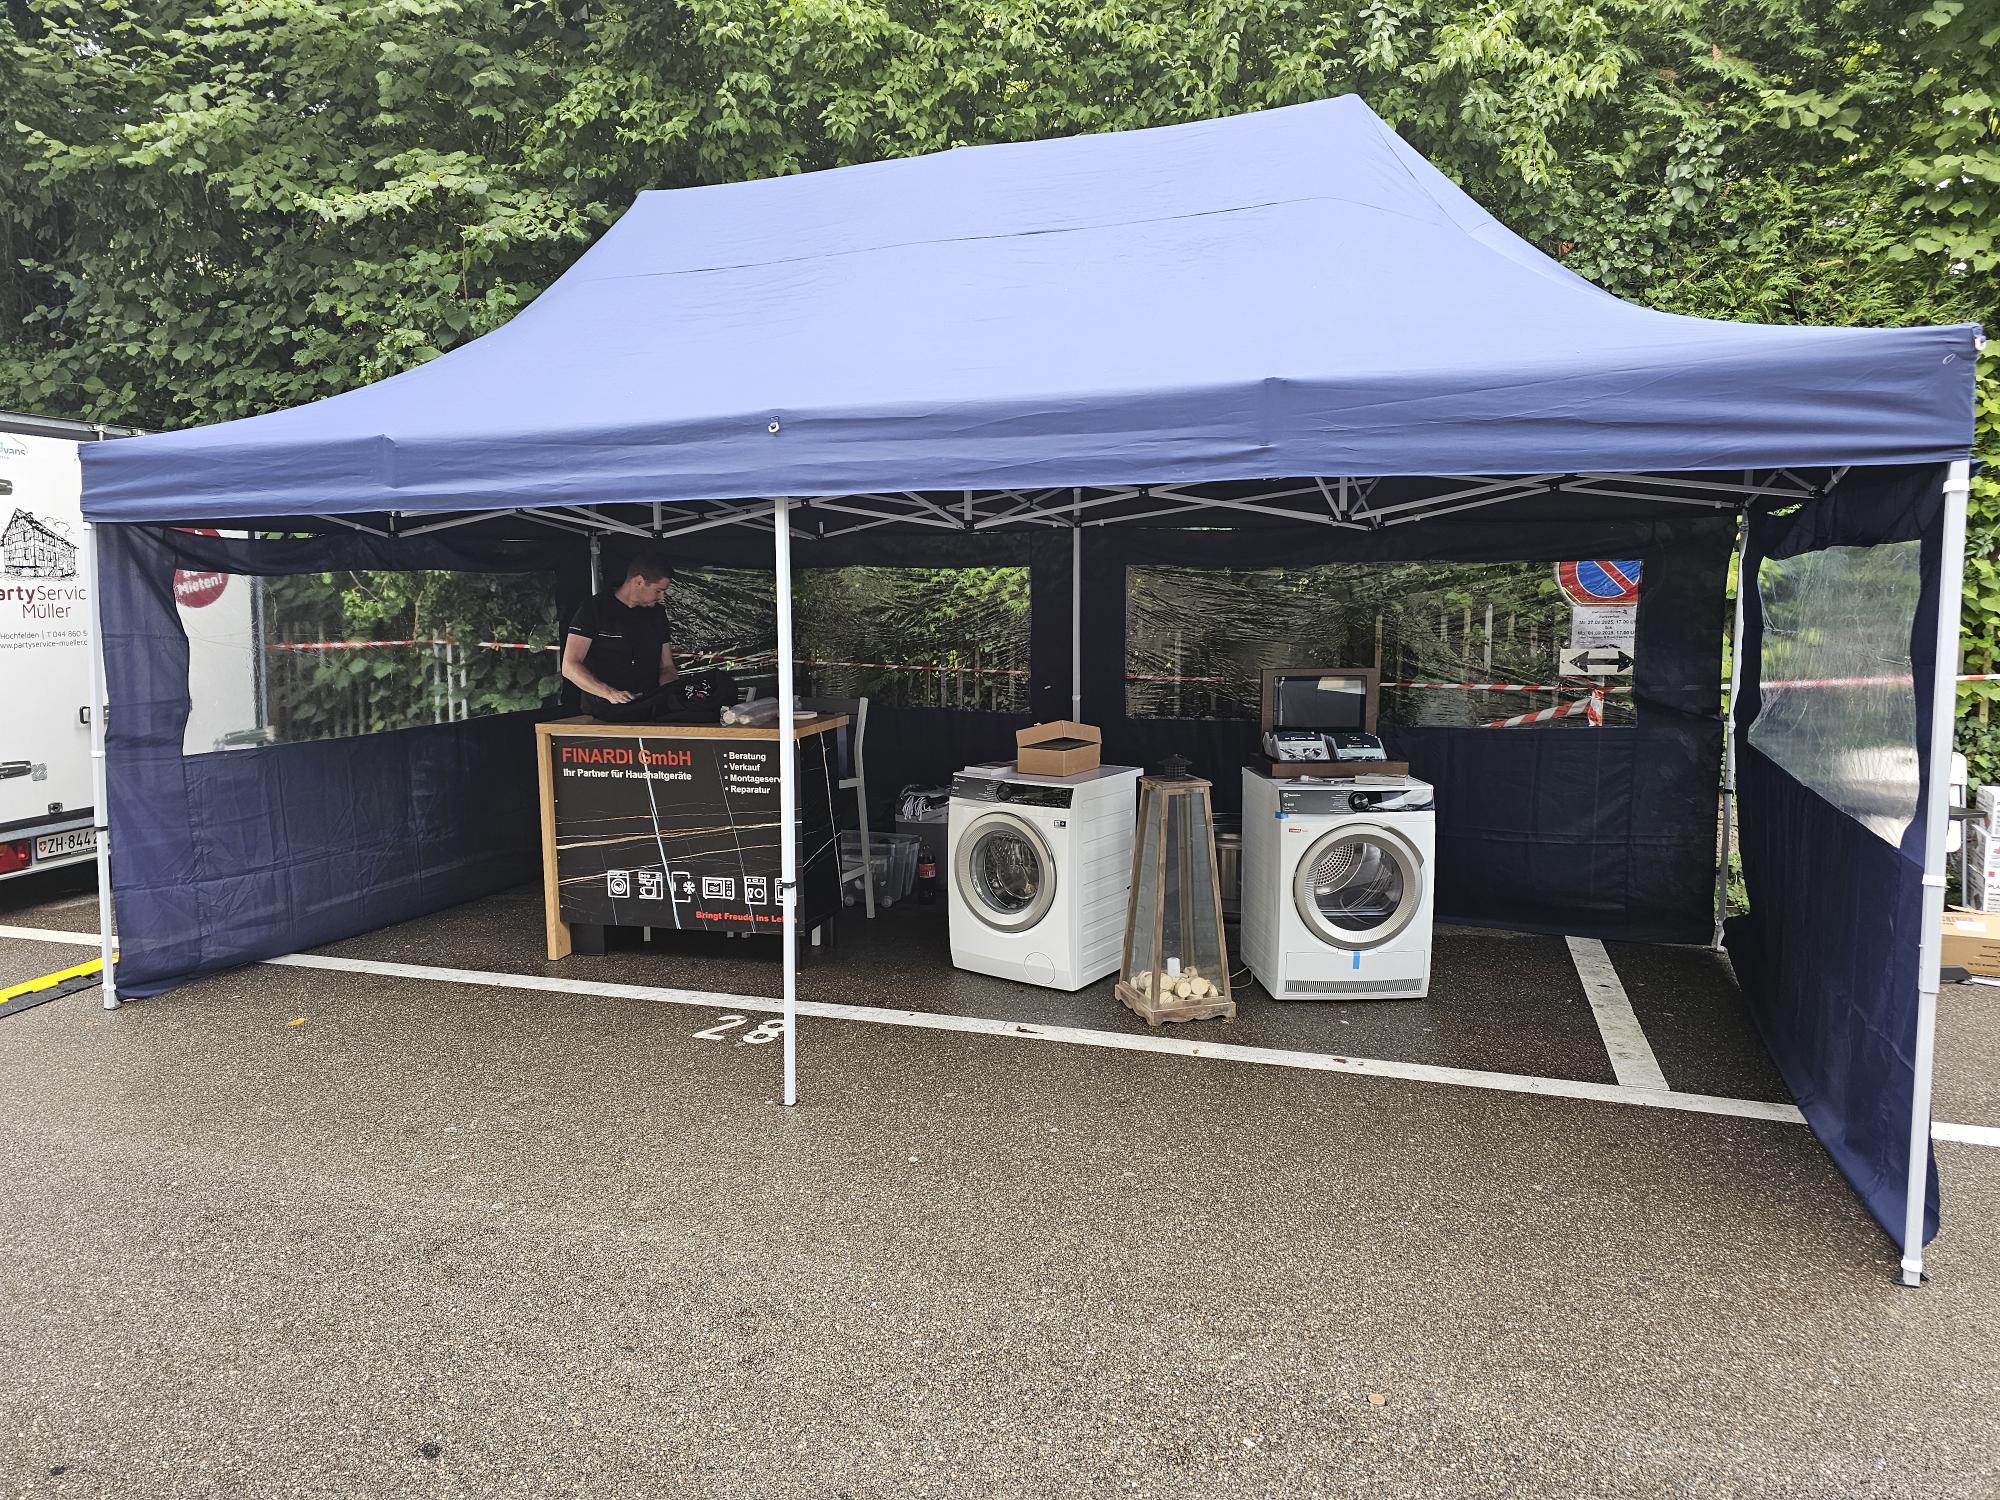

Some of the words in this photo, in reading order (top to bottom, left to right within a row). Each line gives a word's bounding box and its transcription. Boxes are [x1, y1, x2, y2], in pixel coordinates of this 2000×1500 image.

[22, 603, 72, 619] Müller
[562, 747, 633, 765] FINARDI
[638, 749, 692, 766] GmbH
[728, 751, 767, 762] Beratung
[729, 762, 761, 772] Verkauf
[563, 768, 576, 777] Ihr
[577, 768, 609, 778] Partner
[611, 769, 624, 778] für
[625, 770, 692, 782] Haushaltgeräte
[730, 785, 771, 795] Reparatur
[695, 911, 722, 920] Bringt
[724, 912, 754, 921] Freude
[756, 914, 769, 922] ins
[692, 1014, 785, 1044] 28
